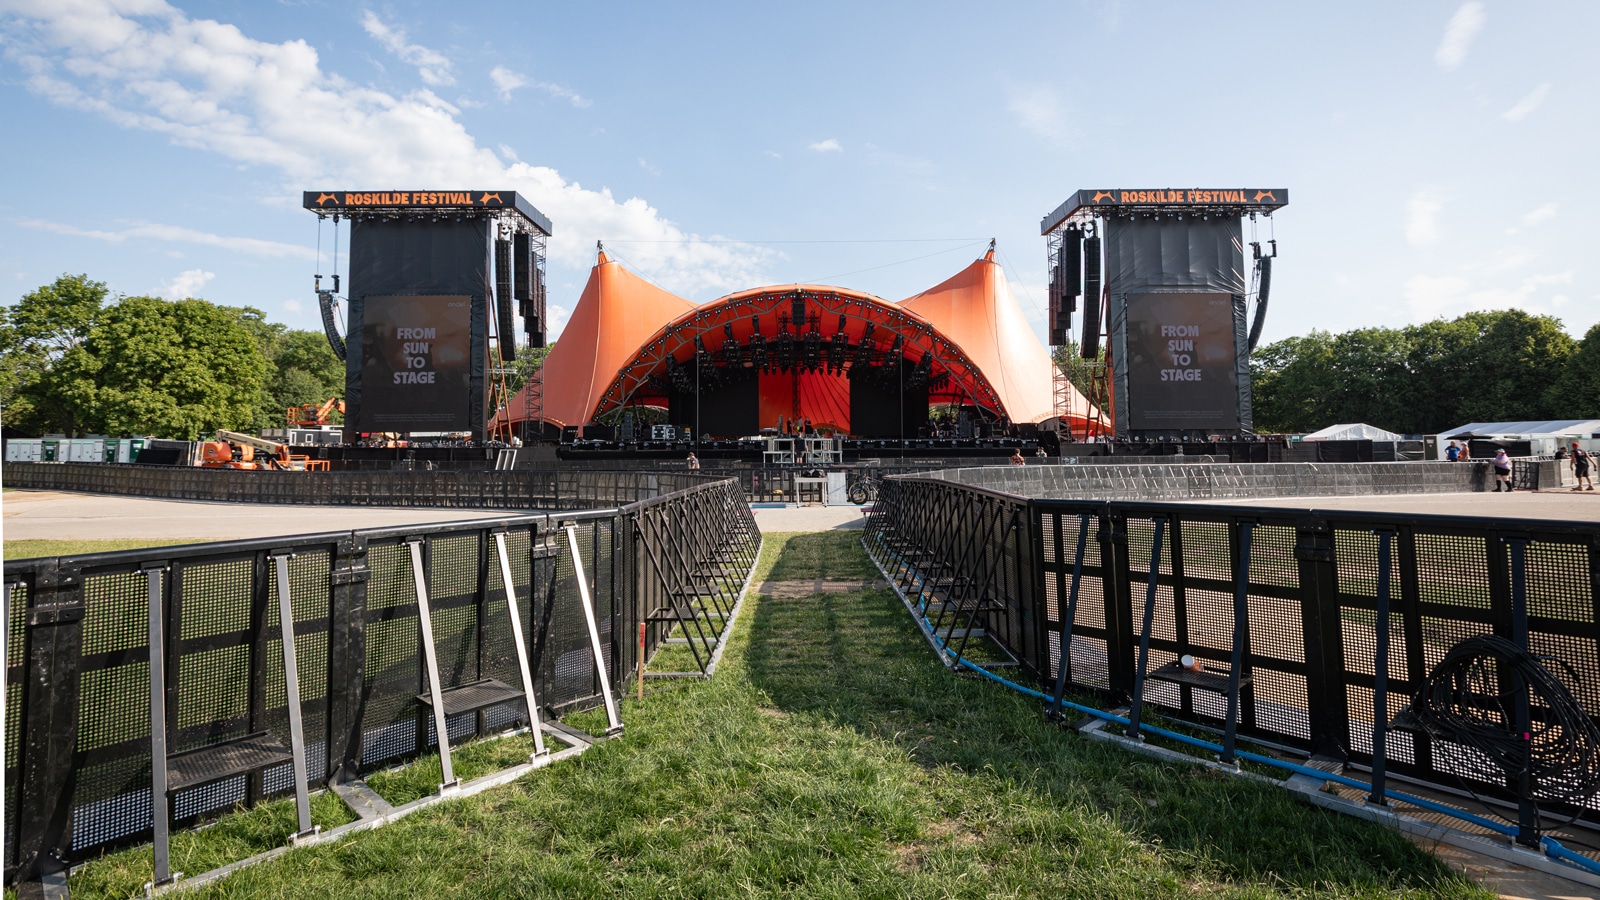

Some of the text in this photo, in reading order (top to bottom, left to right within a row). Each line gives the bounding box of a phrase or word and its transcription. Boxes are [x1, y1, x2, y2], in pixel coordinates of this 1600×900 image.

[345, 192, 473, 205] ROSKILDE FESTIVAL
[1121, 190, 1247, 203] ROSKILDE FESTIVAL
[397, 327, 436, 340] FROM
[1161, 325, 1199, 337] FROM
[403, 342, 429, 355] SUN
[1168, 339, 1194, 352] SUN
[406, 356, 425, 369] TO
[1172, 354, 1191, 366] TO
[393, 371, 436, 384] STAGE
[1160, 368, 1202, 381] STAGE
